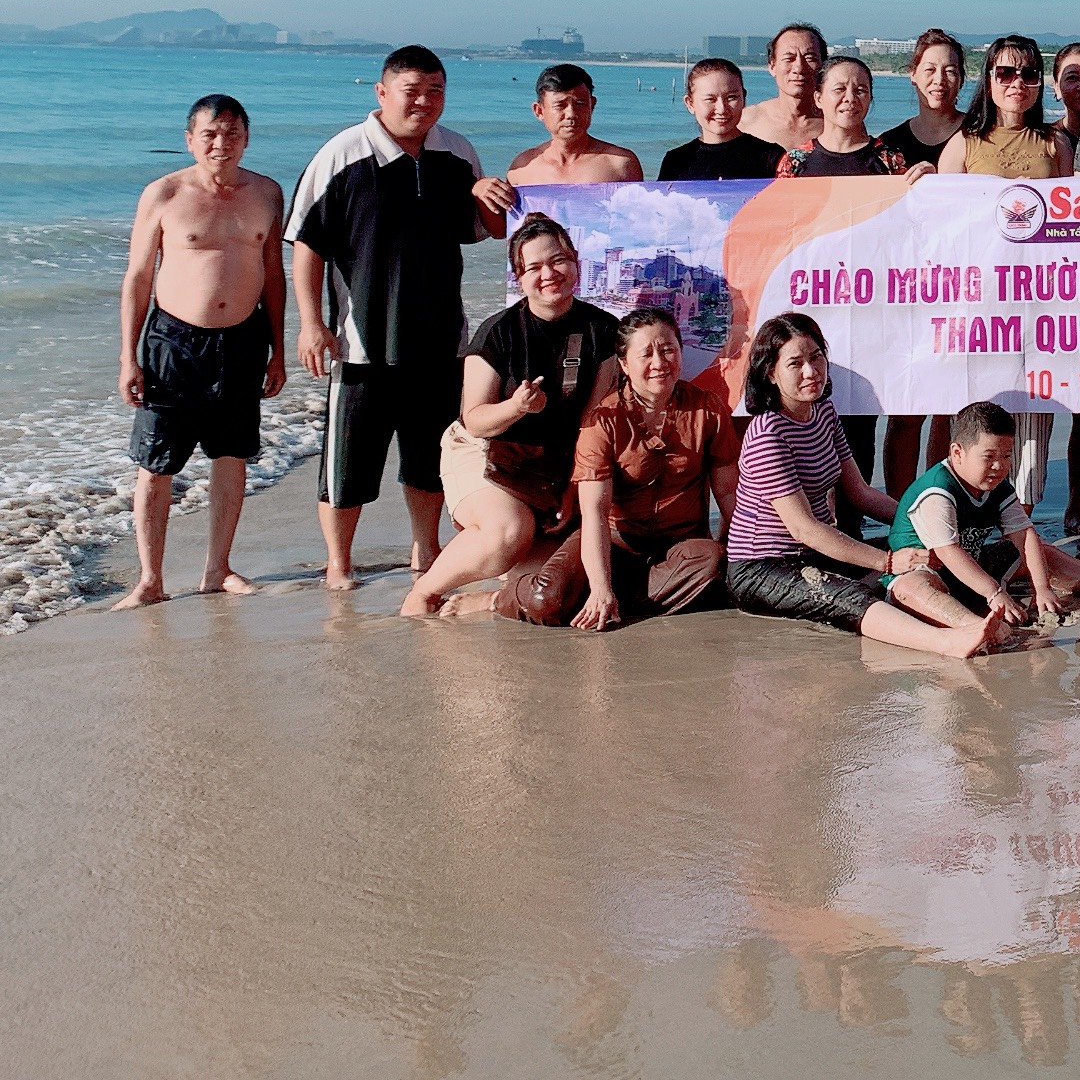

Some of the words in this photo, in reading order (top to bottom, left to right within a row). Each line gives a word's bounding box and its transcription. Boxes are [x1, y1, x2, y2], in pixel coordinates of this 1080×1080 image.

[1045, 227, 1067, 237] Nhà
[789, 261, 874, 305] CHÀO
[887, 259, 982, 303] MỪNG
[931, 316, 1022, 353] THAM
[1026, 370, 1053, 400] 10
